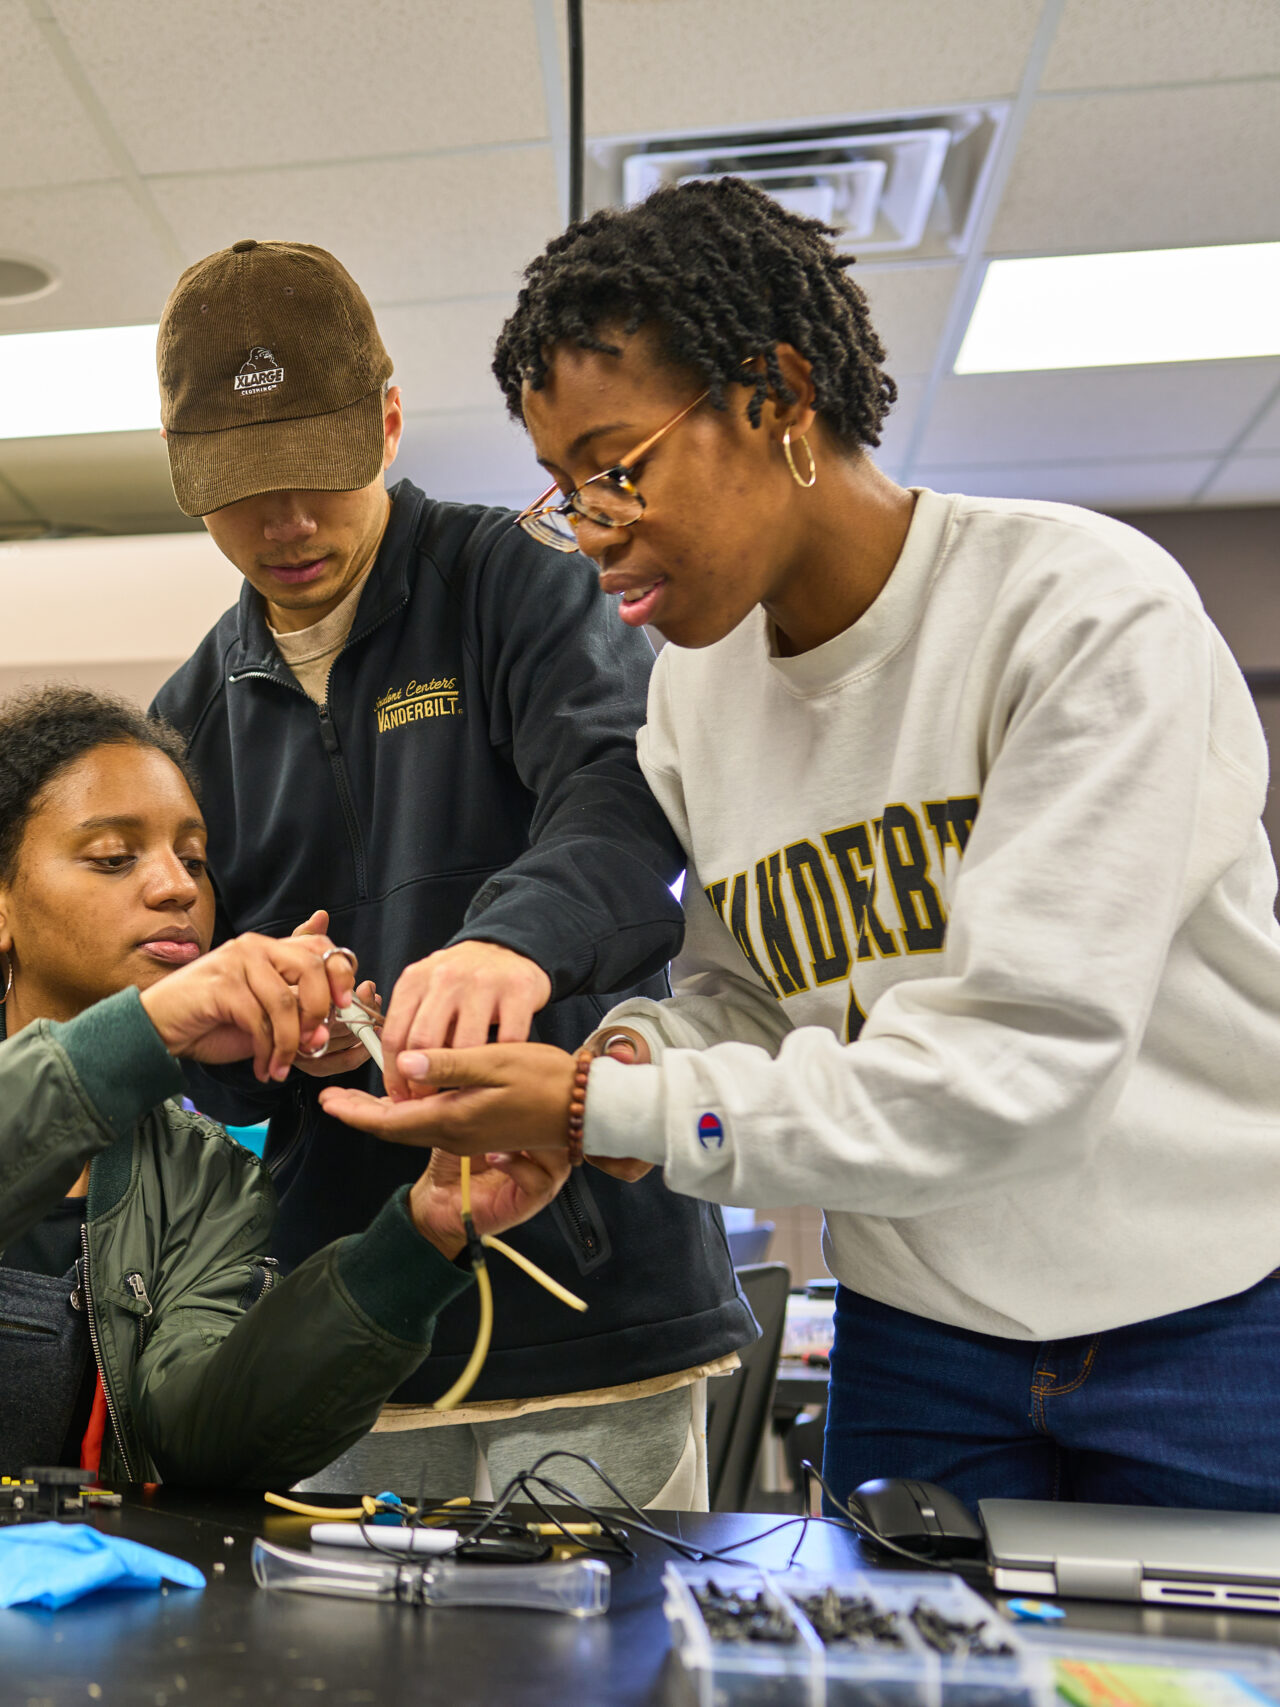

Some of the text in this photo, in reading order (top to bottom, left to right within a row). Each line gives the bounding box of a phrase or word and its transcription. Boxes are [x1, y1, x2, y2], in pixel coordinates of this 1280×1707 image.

[236, 369, 282, 388] XLARGE
[405, 677, 457, 697] Centers
[377, 697, 459, 733] VANDERBILT
